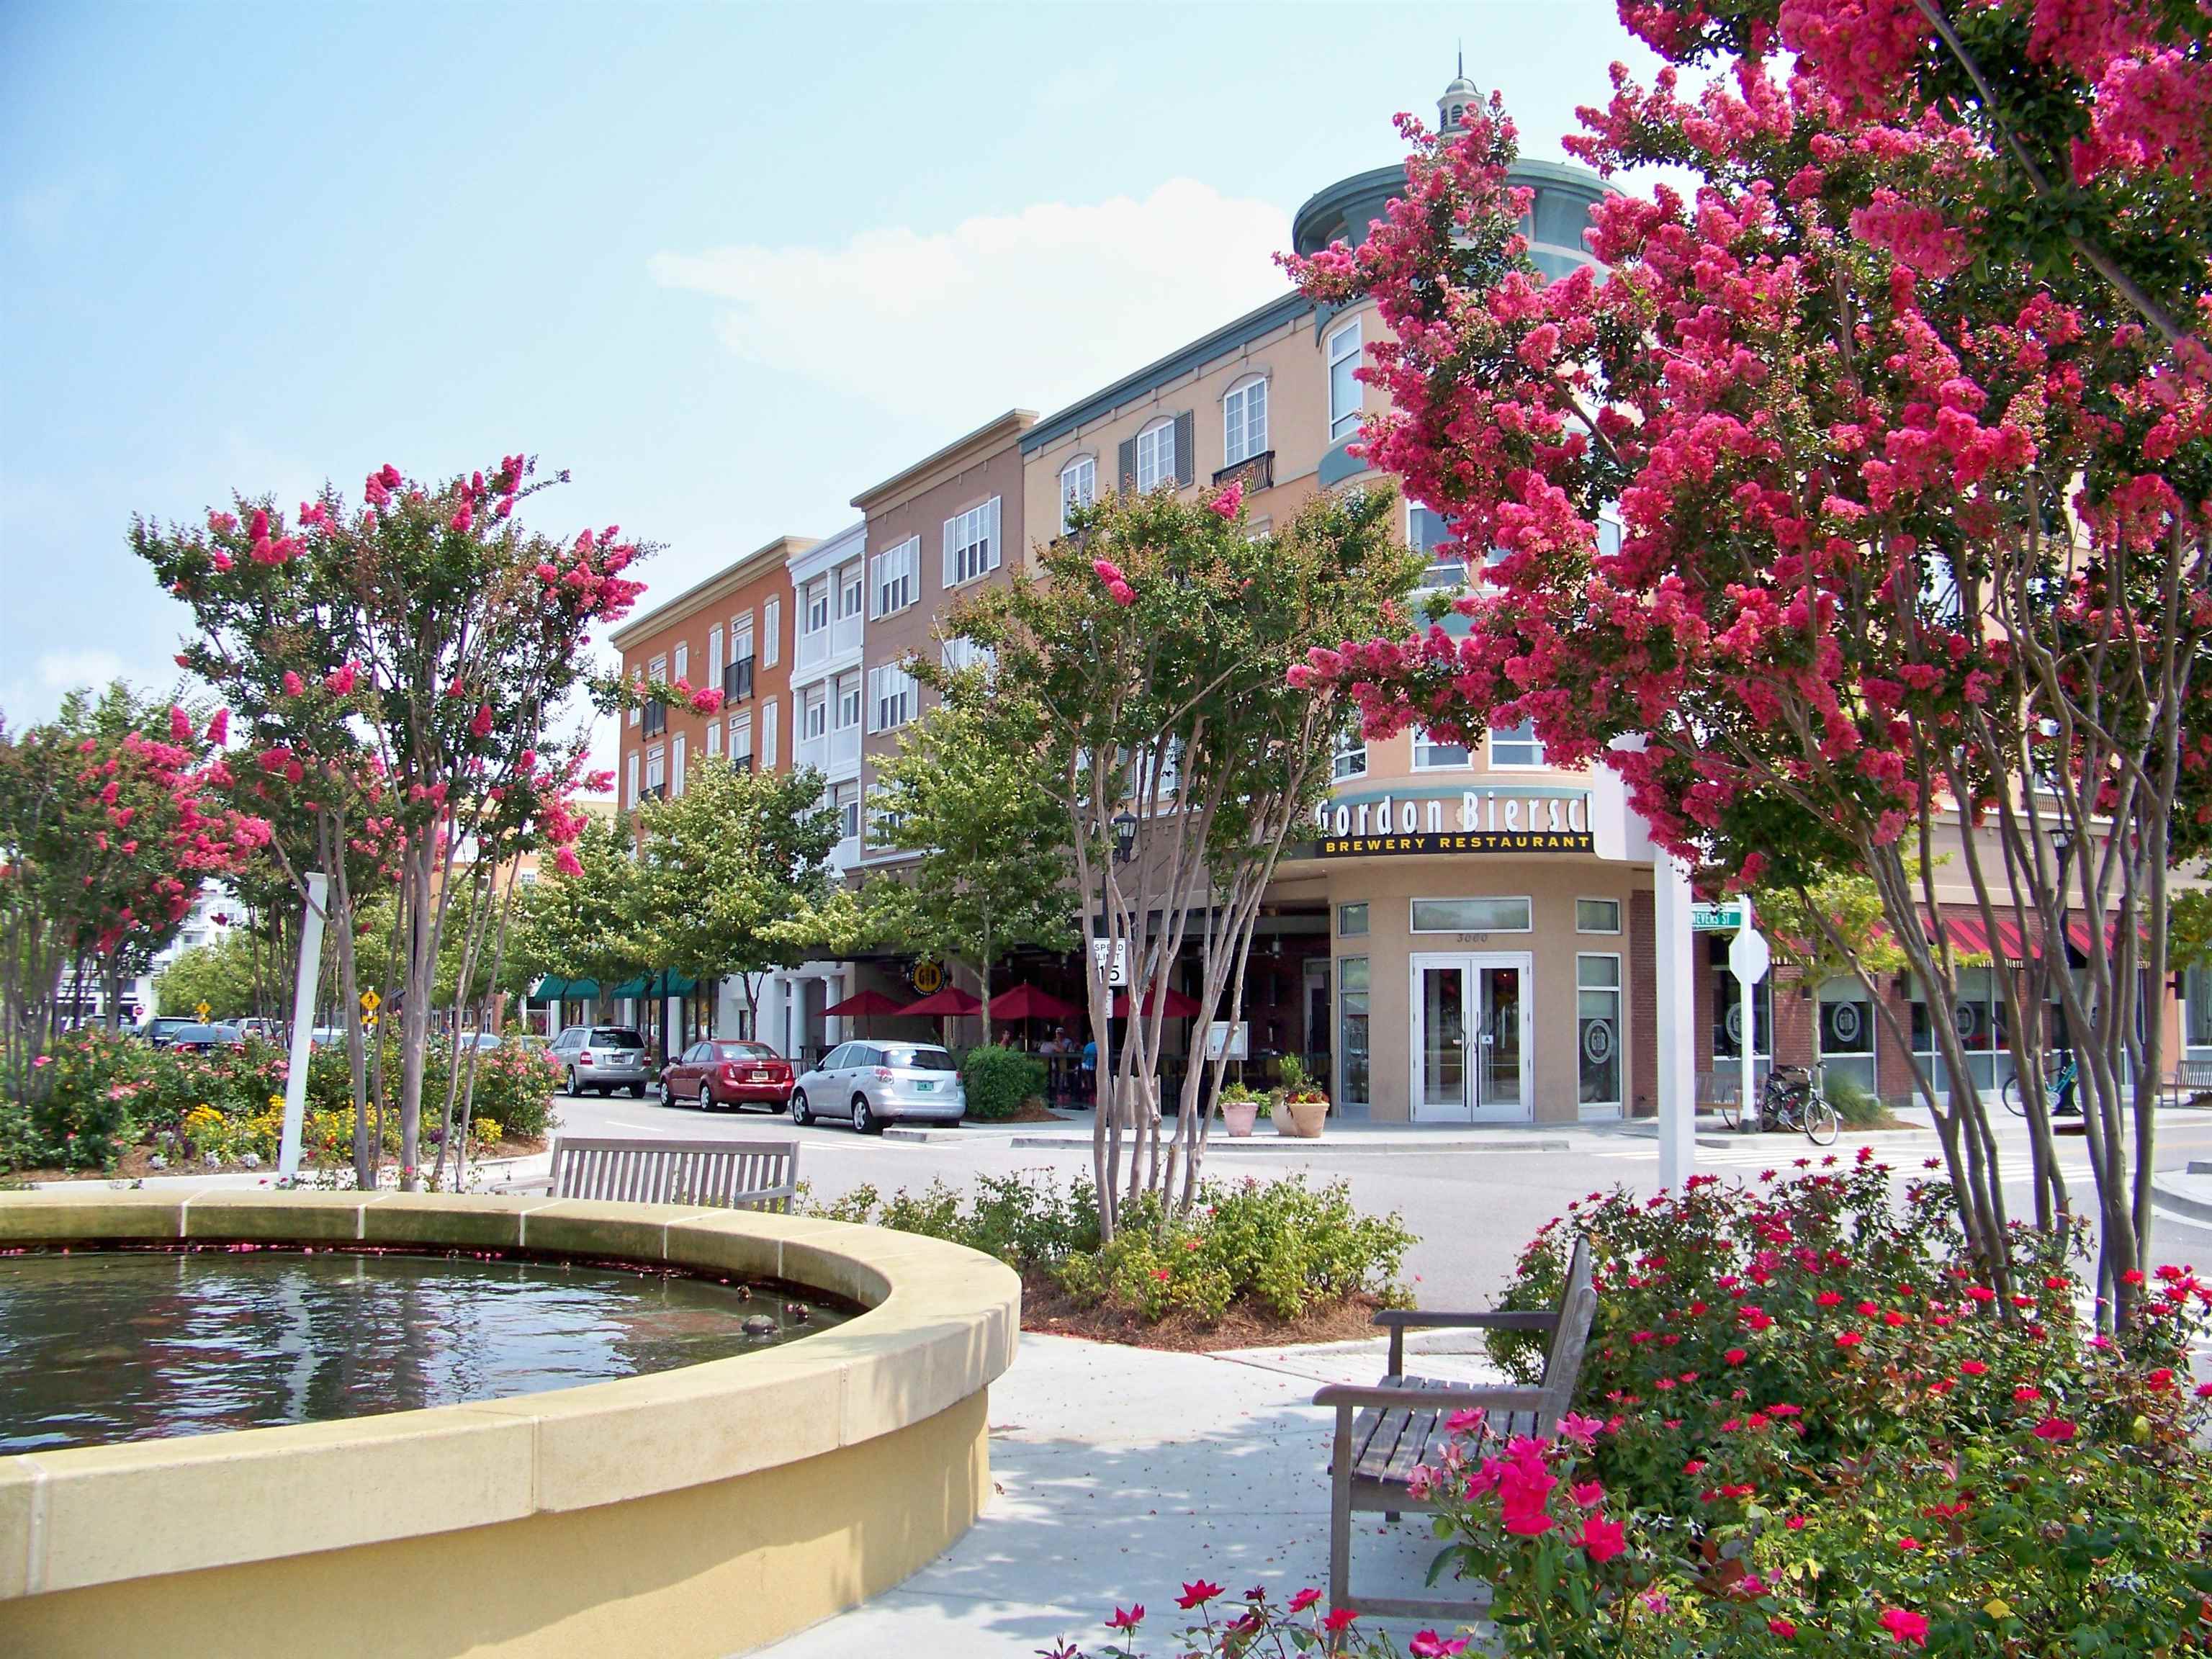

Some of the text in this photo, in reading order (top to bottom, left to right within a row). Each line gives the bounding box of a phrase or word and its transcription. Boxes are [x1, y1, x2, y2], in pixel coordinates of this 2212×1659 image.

[1315, 795, 1442, 837] Gordon
[1326, 837, 1589, 853] BREWERY RESTAURANT
[1721, 912, 1731, 925] ST
[1099, 965, 1120, 981] 15
